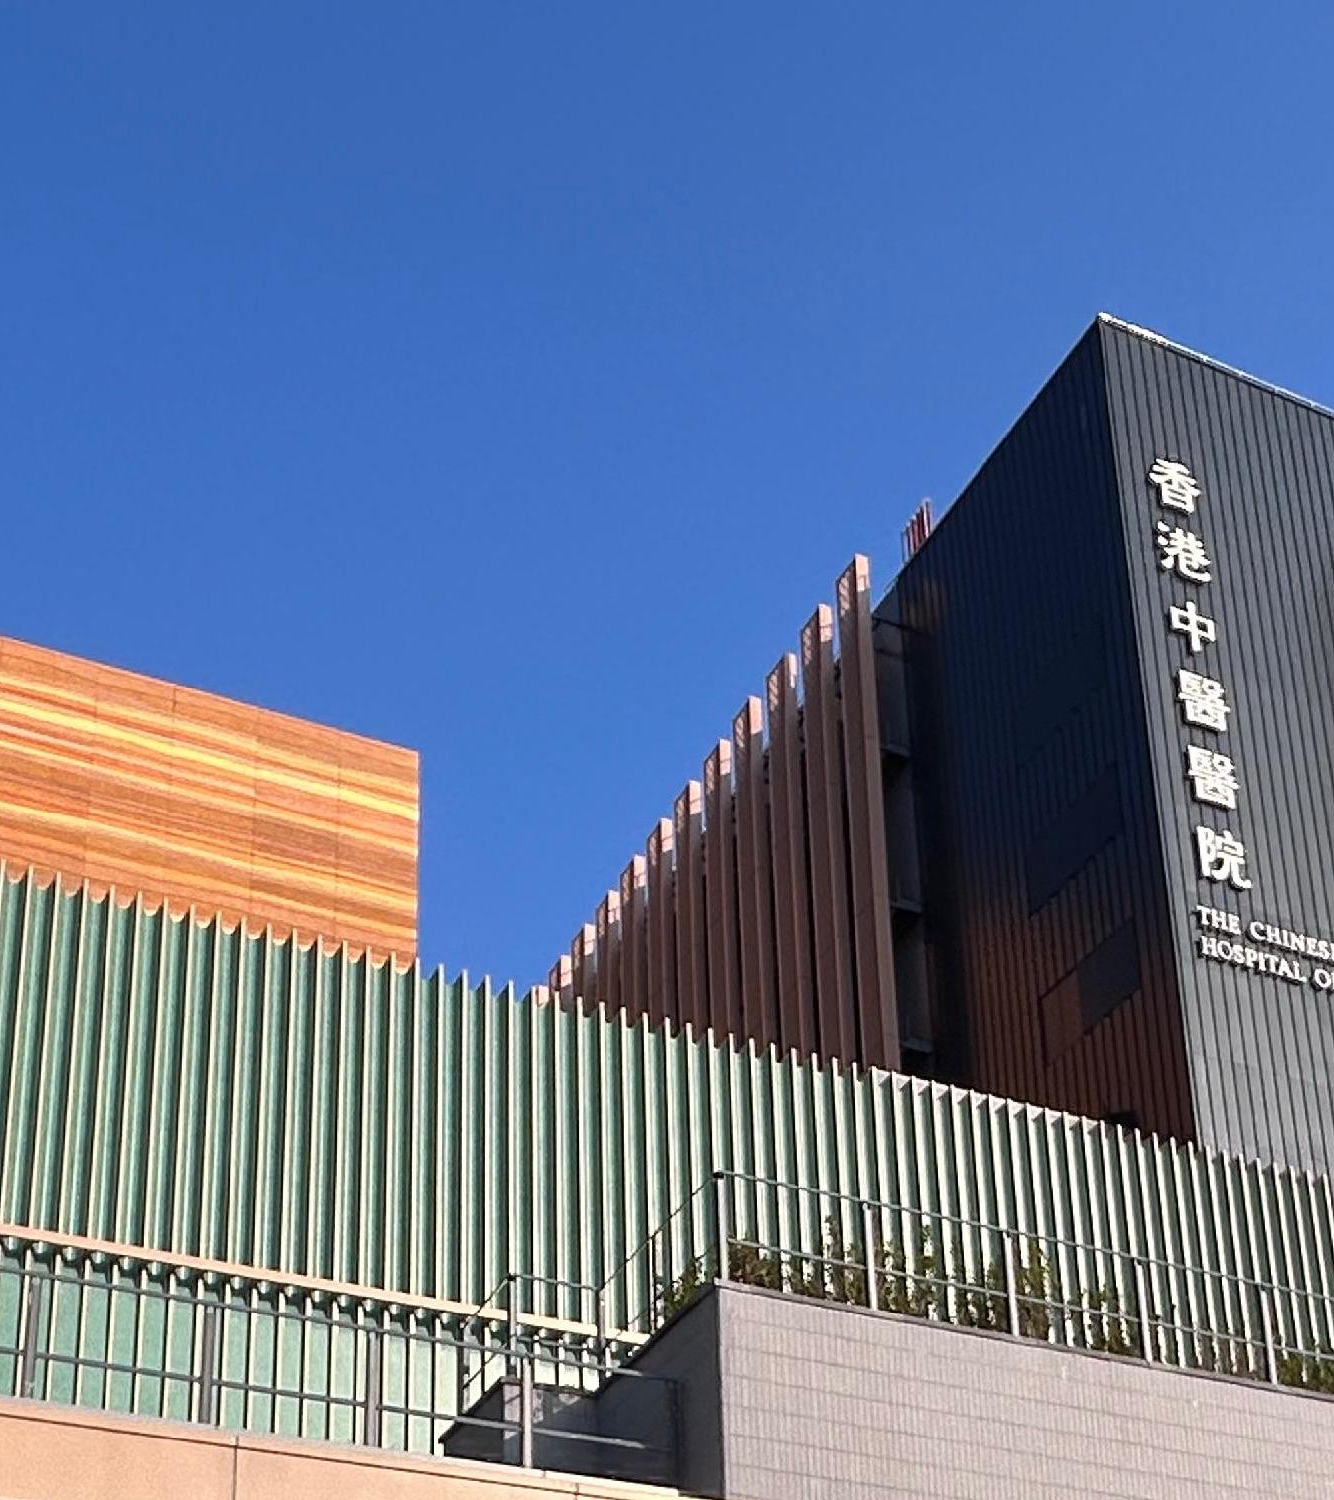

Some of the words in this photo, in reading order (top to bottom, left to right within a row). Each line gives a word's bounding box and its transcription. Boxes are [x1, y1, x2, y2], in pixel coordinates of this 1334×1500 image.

[1148, 456, 1252, 890] 香港中醫醫院
[1197, 905, 1240, 936] THE
[1201, 936, 1307, 983] HOSPITAL
